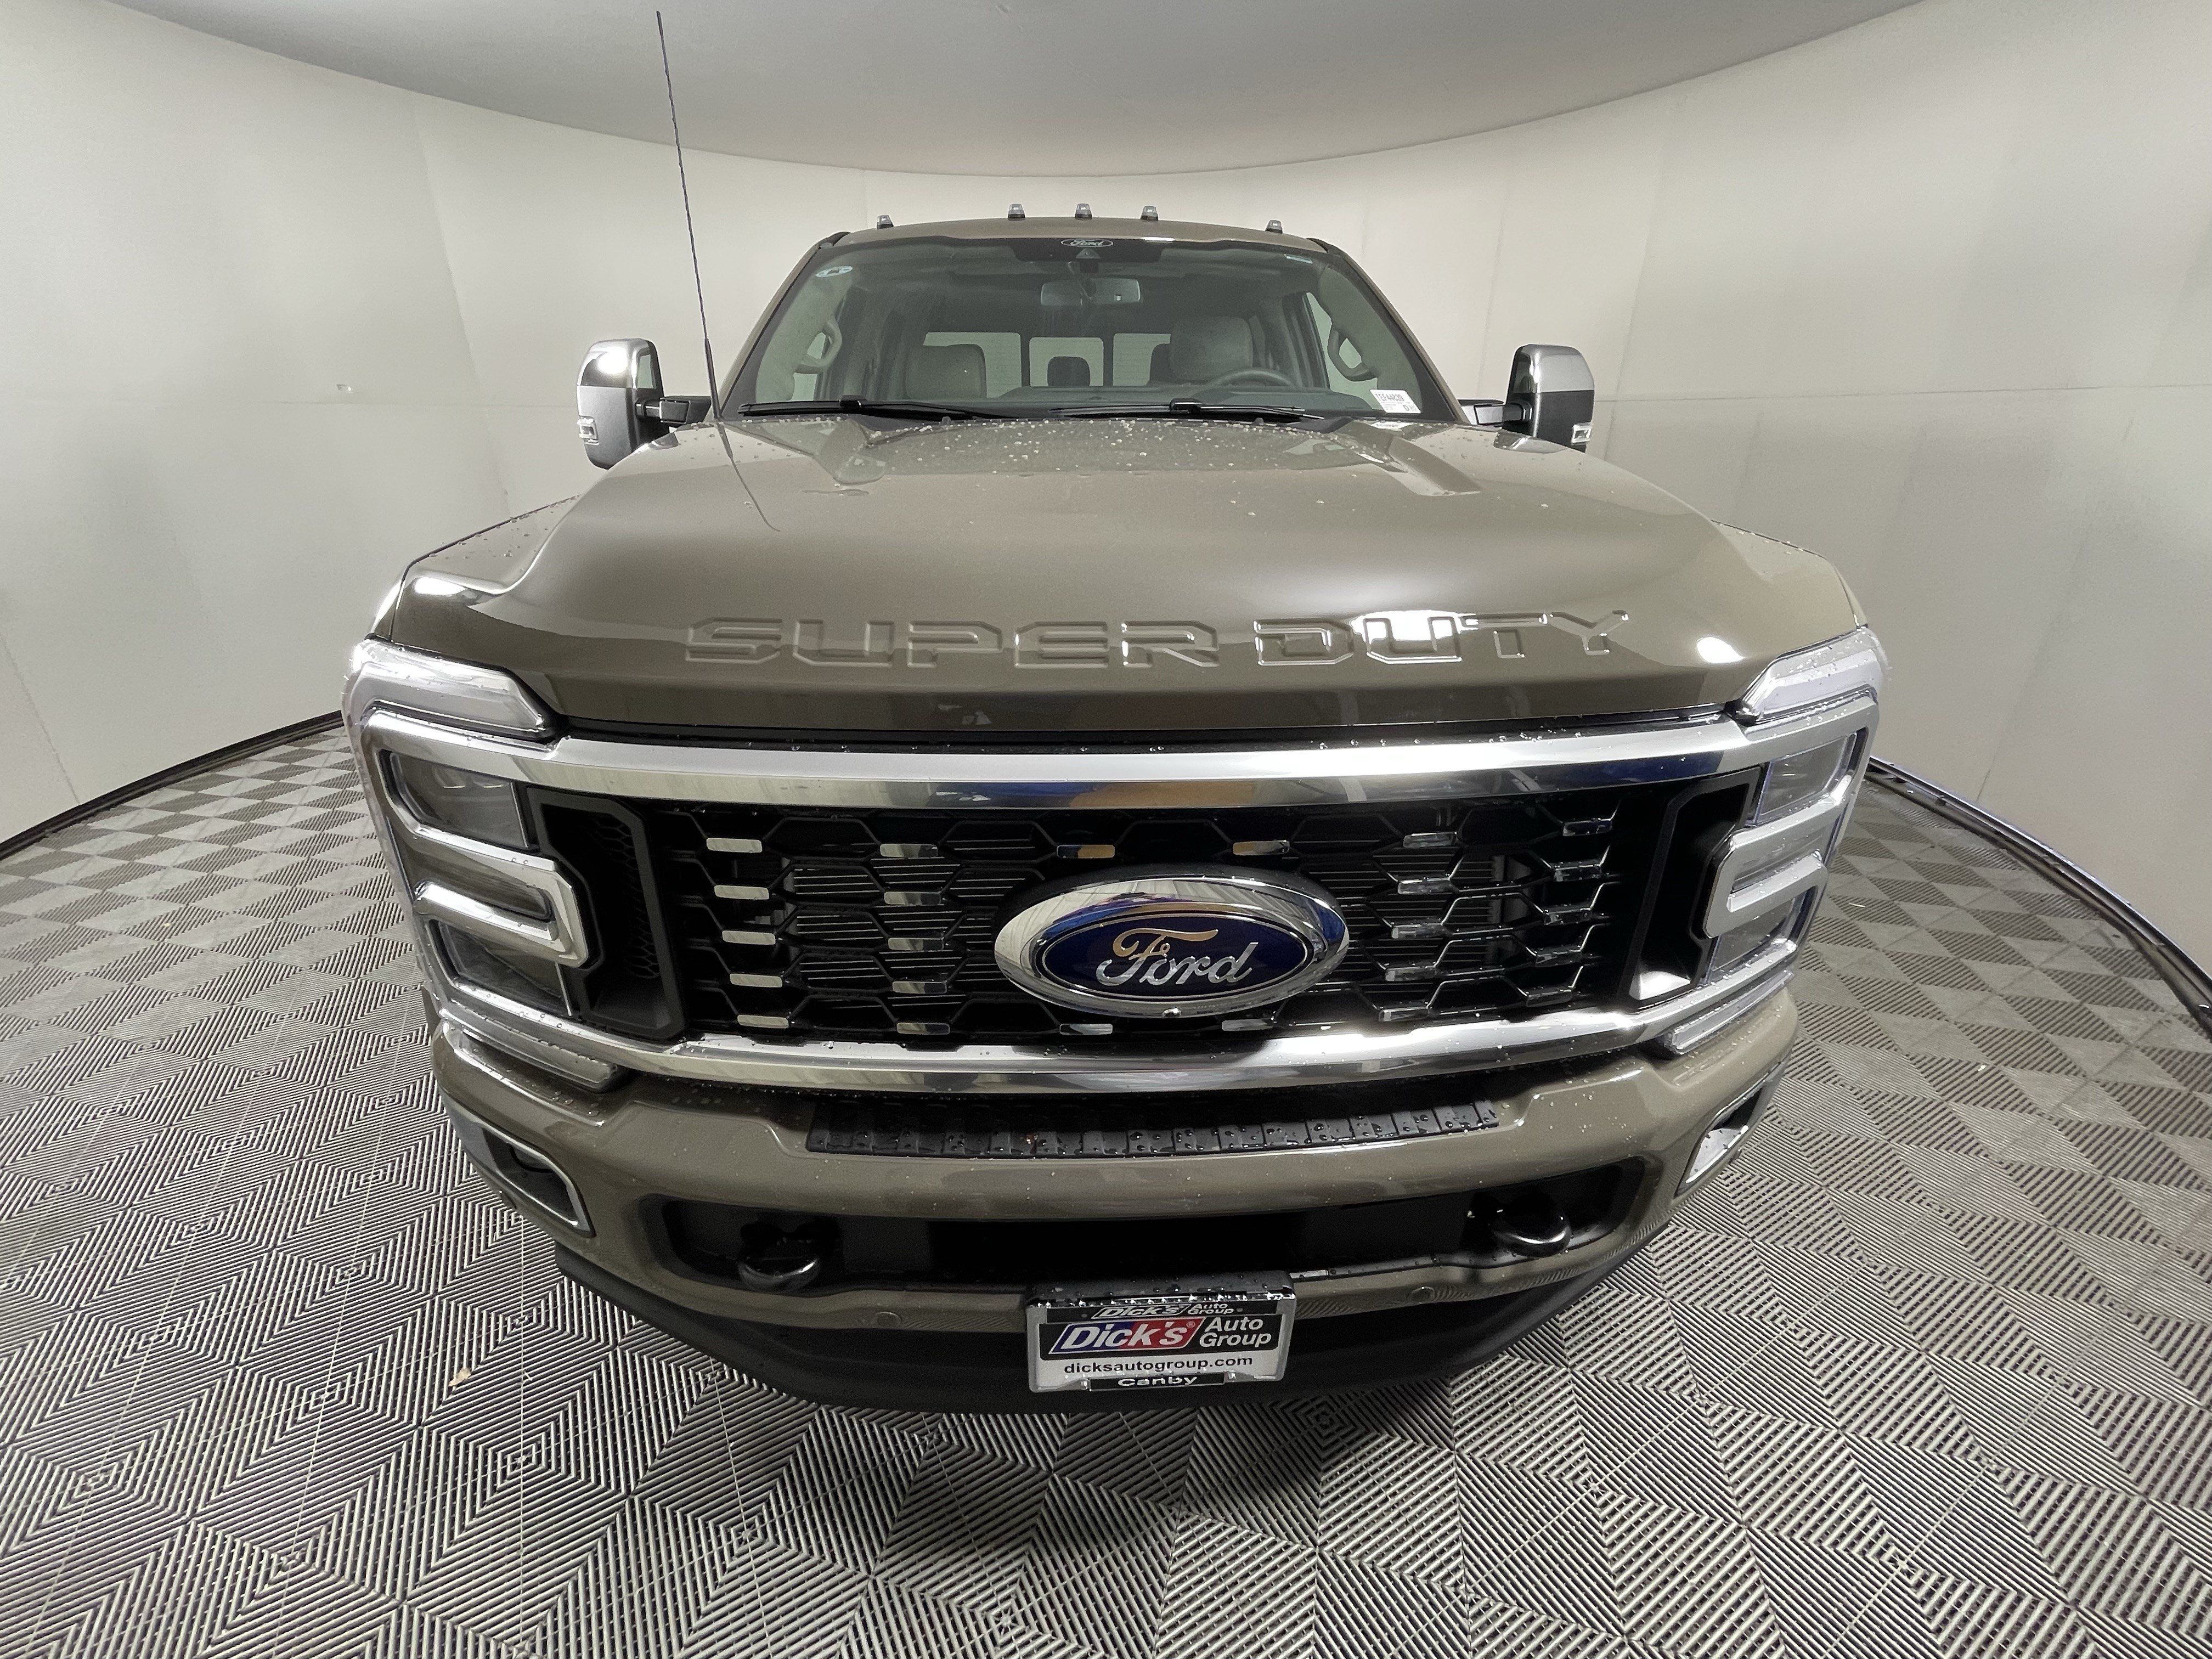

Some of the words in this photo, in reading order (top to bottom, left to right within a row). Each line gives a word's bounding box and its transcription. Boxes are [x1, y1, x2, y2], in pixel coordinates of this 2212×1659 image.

[685, 617, 1220, 669] SUPER
[1253, 609, 1630, 666] DUTY
[1096, 928, 1259, 986] Ford
[1204, 1317, 1263, 1332] Auto
[1199, 1332, 1272, 1348] Group
[1064, 1357, 1252, 1373] dicksautogroup.com
